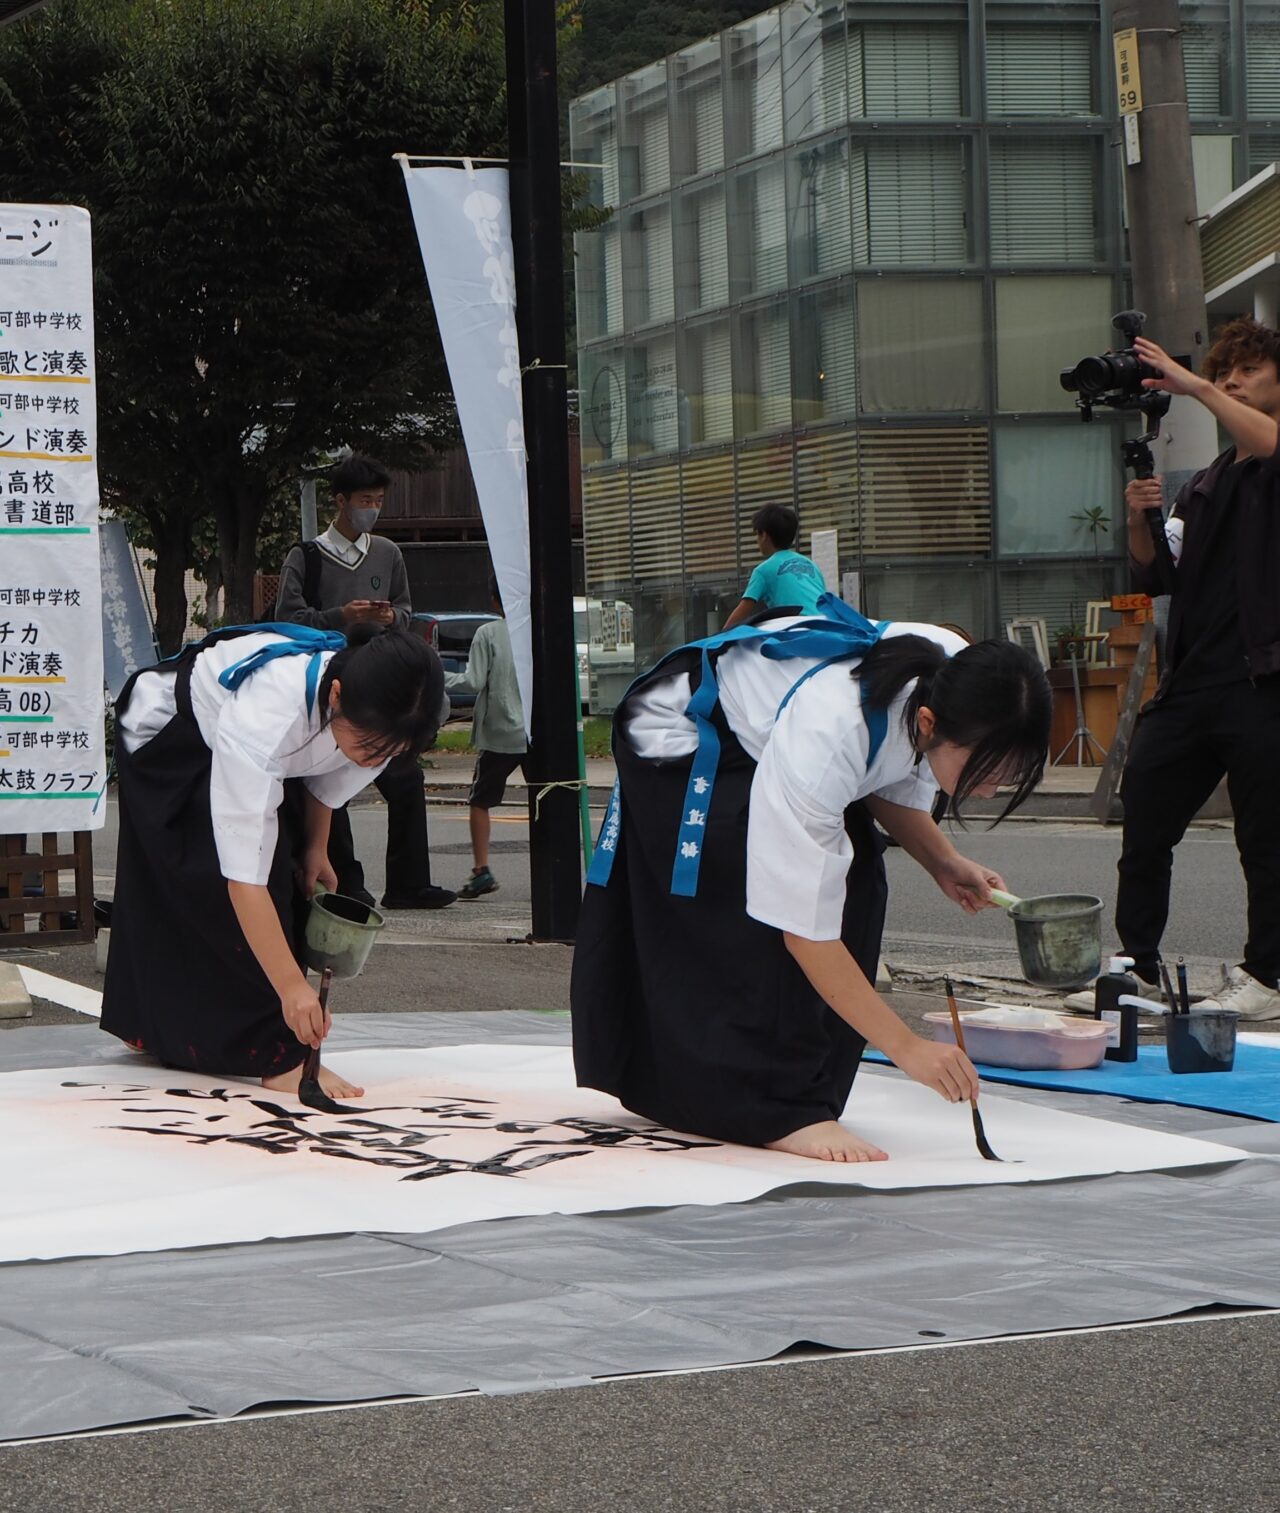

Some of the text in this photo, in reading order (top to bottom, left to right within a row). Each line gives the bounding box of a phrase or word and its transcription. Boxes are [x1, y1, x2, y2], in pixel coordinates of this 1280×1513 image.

[1119, 90, 1138, 108] 69
[3, 498, 75, 526] 書道部
[5, 730, 89, 749] 可部中学校
[680, 776, 710, 859] 書道部
